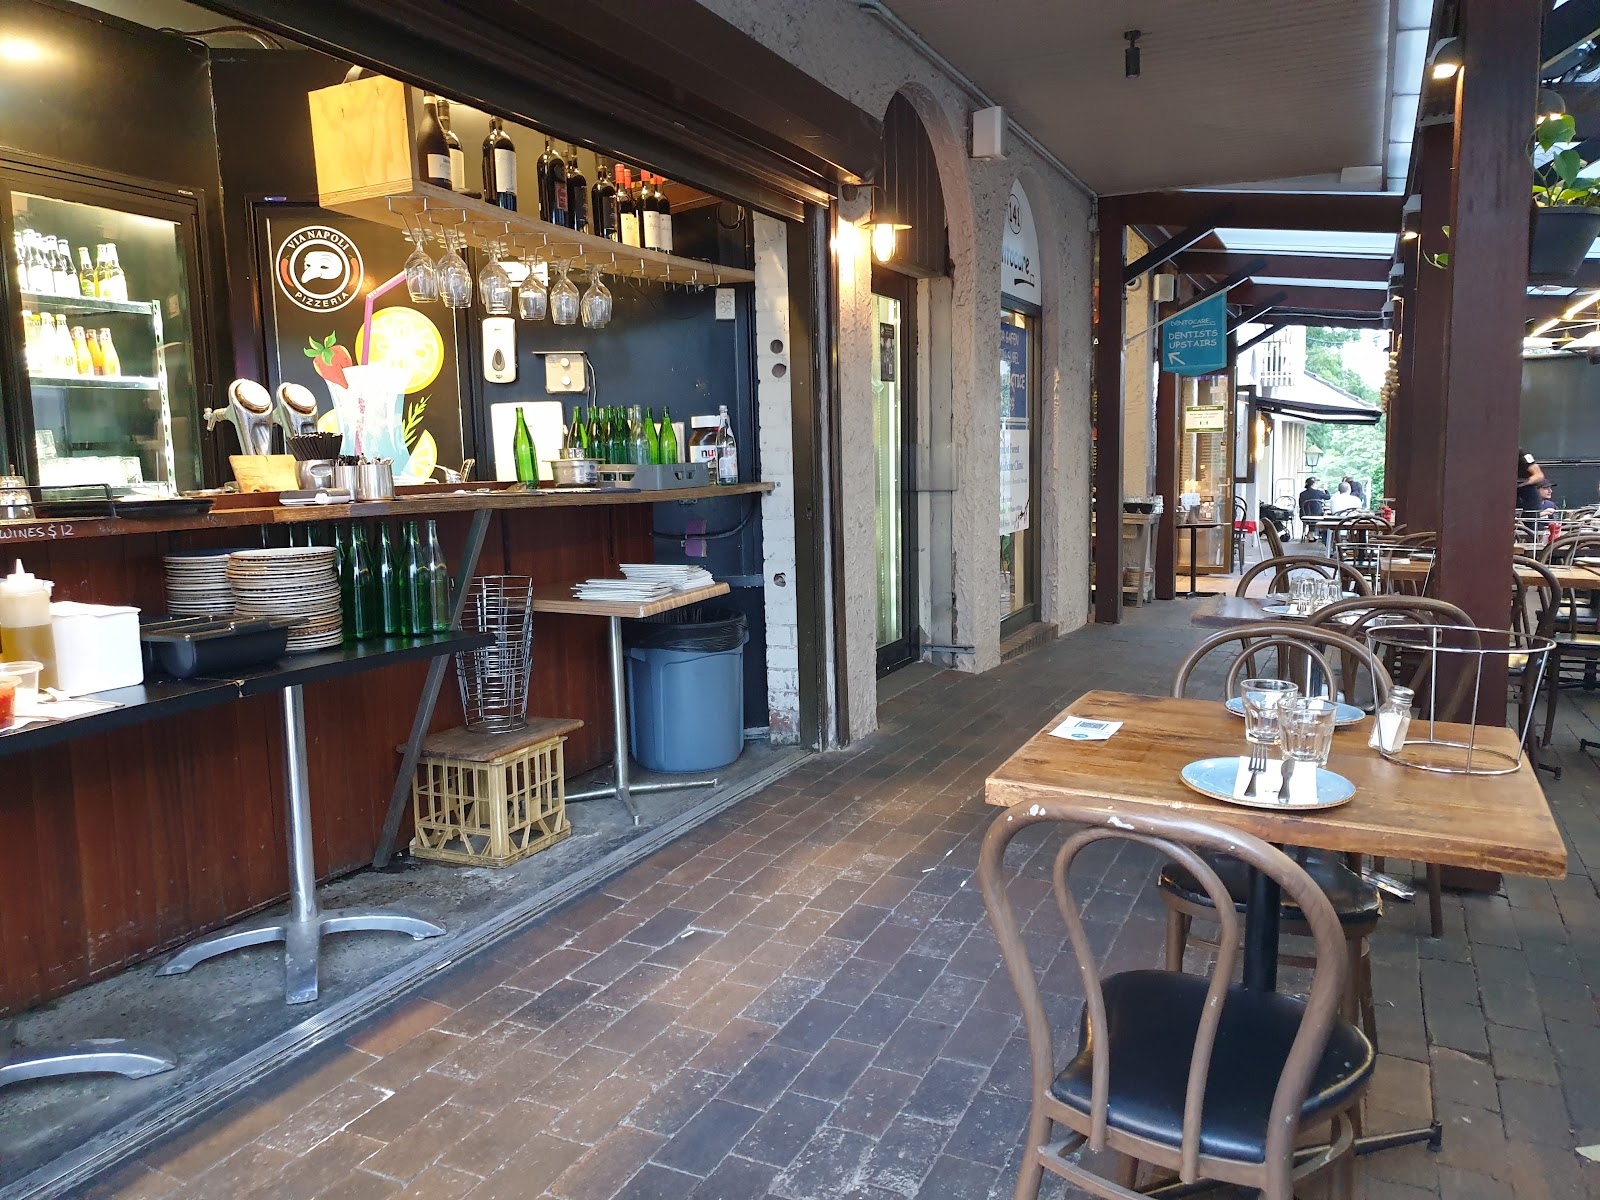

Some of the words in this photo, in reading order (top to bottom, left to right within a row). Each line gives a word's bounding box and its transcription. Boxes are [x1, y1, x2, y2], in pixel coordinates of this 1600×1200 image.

[1009, 202, 1020, 227] 141
[287, 234, 306, 249] VIA
[307, 230, 349, 250] NAPOLI
[295, 292, 348, 307] PIZZERIA
[1168, 330, 1218, 339] DENTISTS
[1169, 339, 1217, 349] UPSTAIRS
[0, 527, 46, 538] WINES
